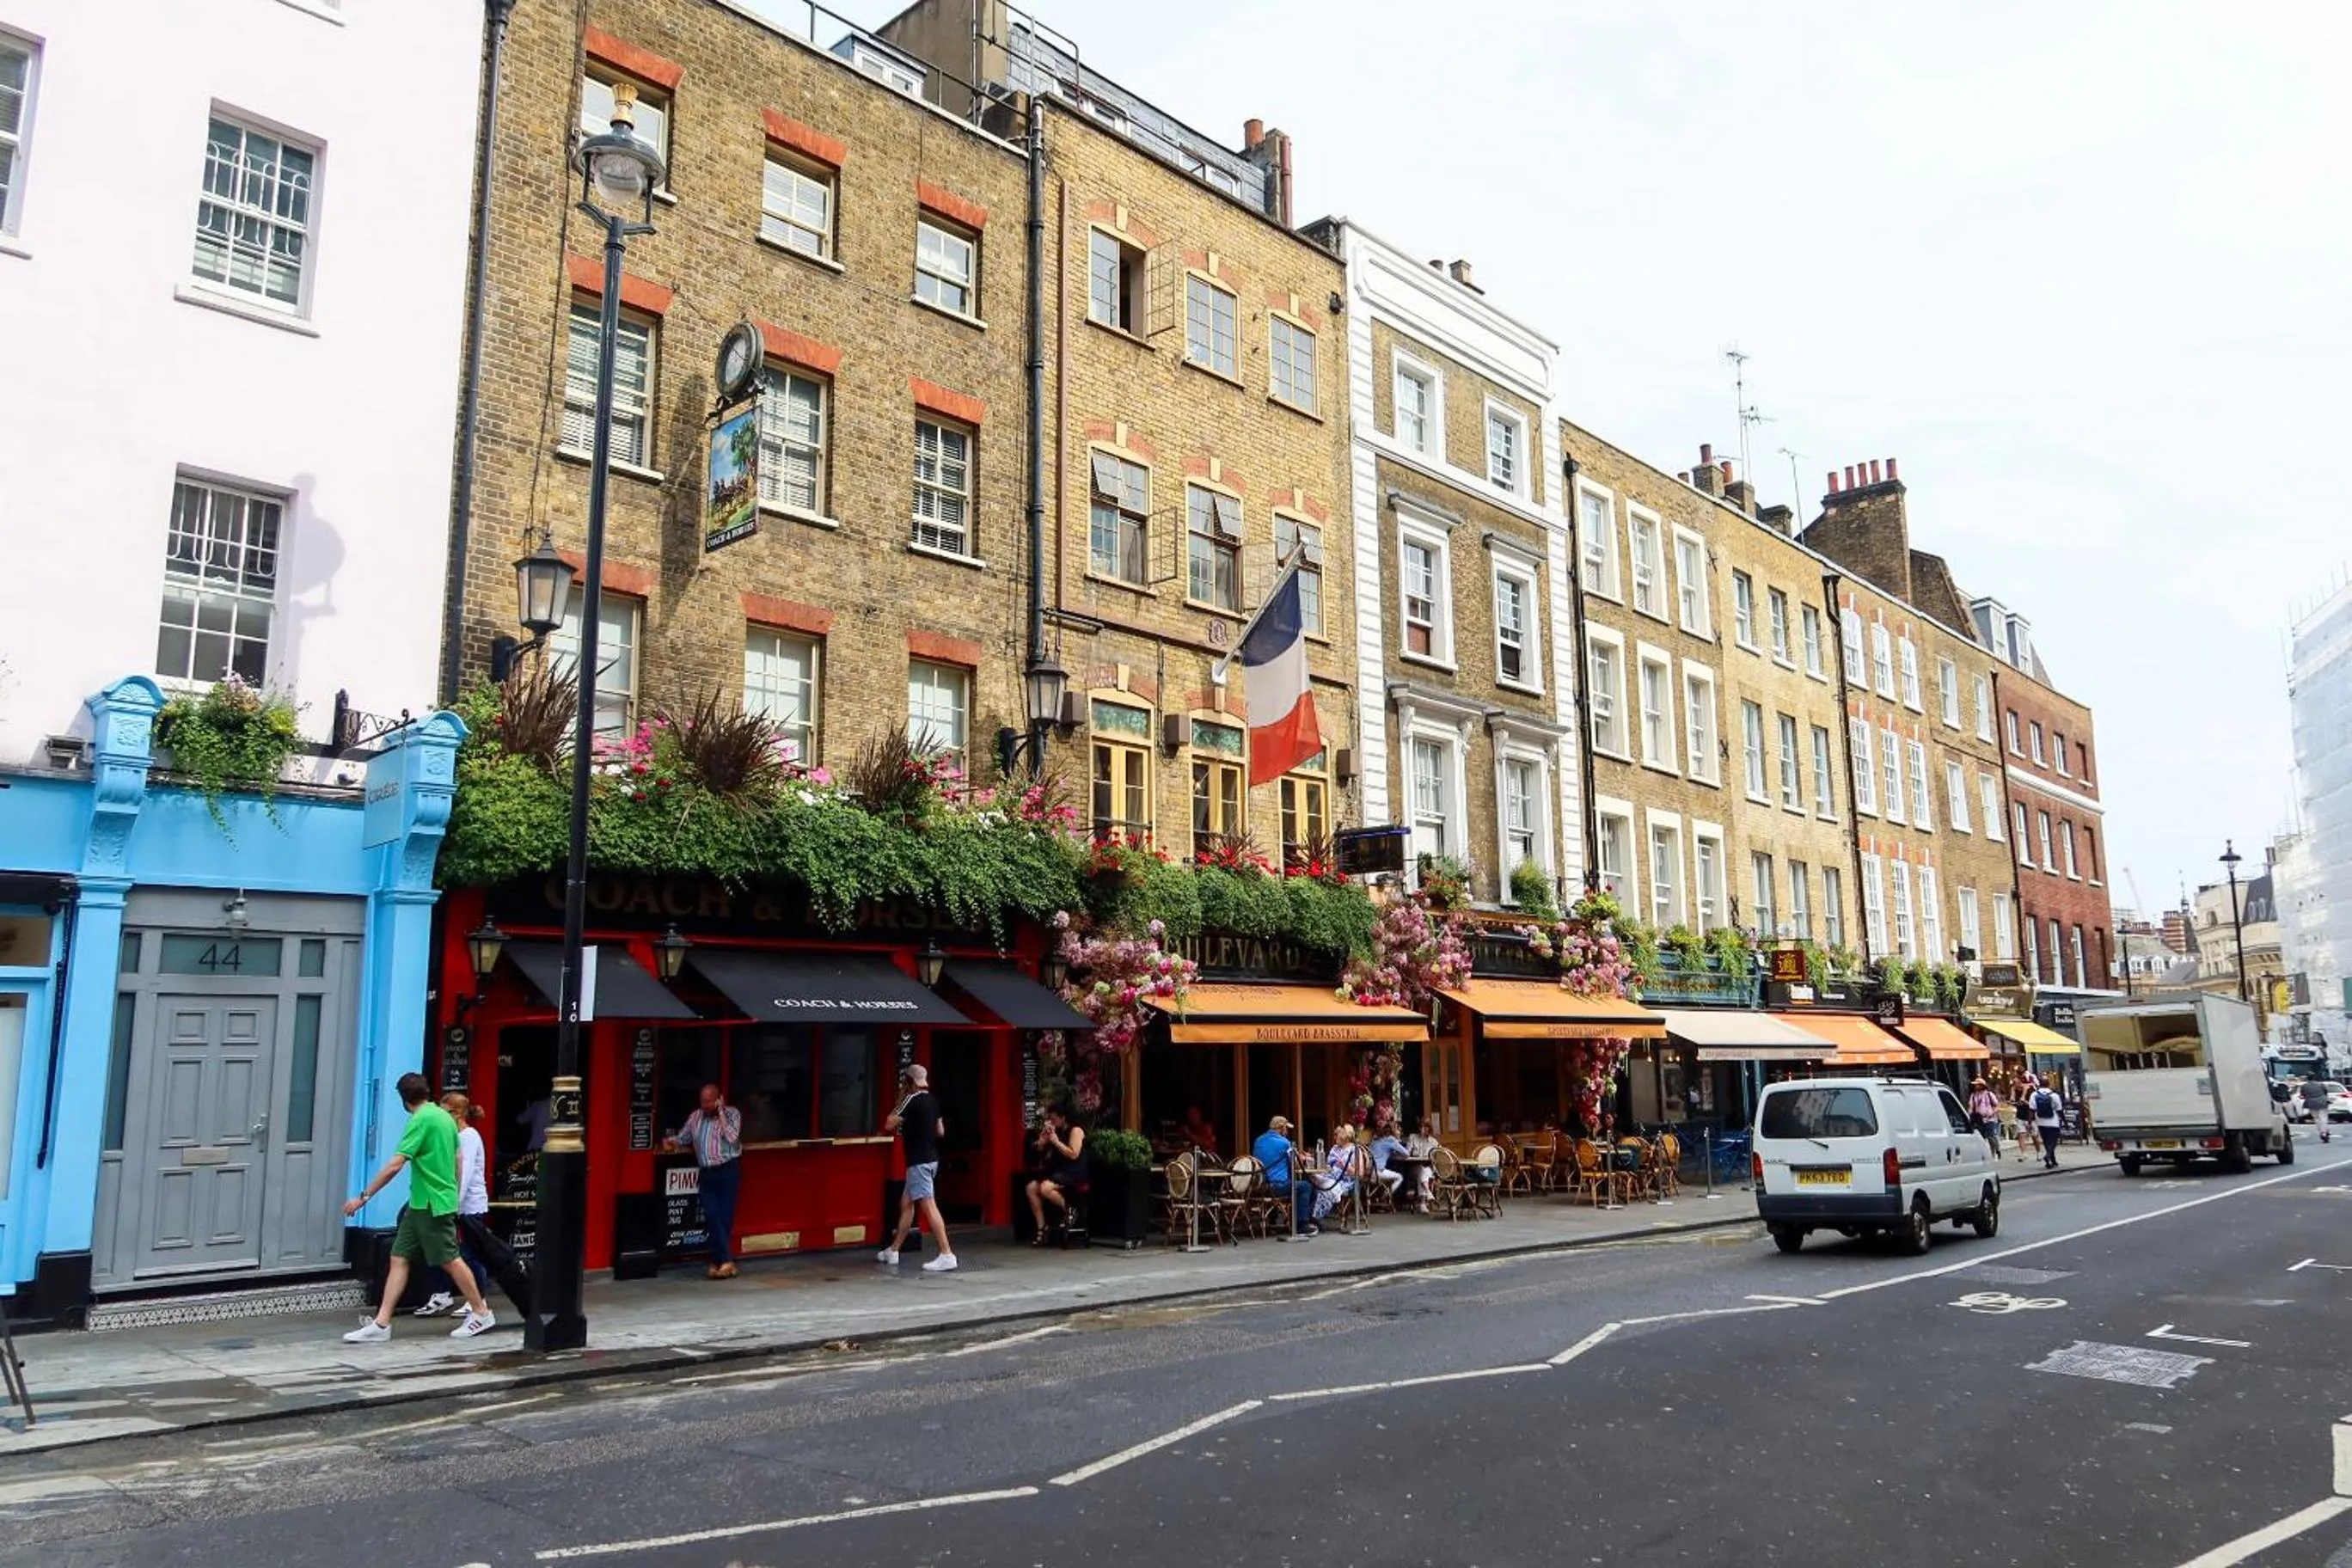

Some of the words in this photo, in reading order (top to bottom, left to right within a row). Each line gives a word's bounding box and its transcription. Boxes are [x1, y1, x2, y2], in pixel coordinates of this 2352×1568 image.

[543, 872, 731, 917] COACH
[752, 894, 784, 922] &
[199, 943, 242, 972] 44
[774, 999, 838, 1008] COACH
[839, 1000, 854, 1008] &
[854, 1001, 919, 1009] HORSES
[1257, 1028, 1308, 1039] BOULEVARD
